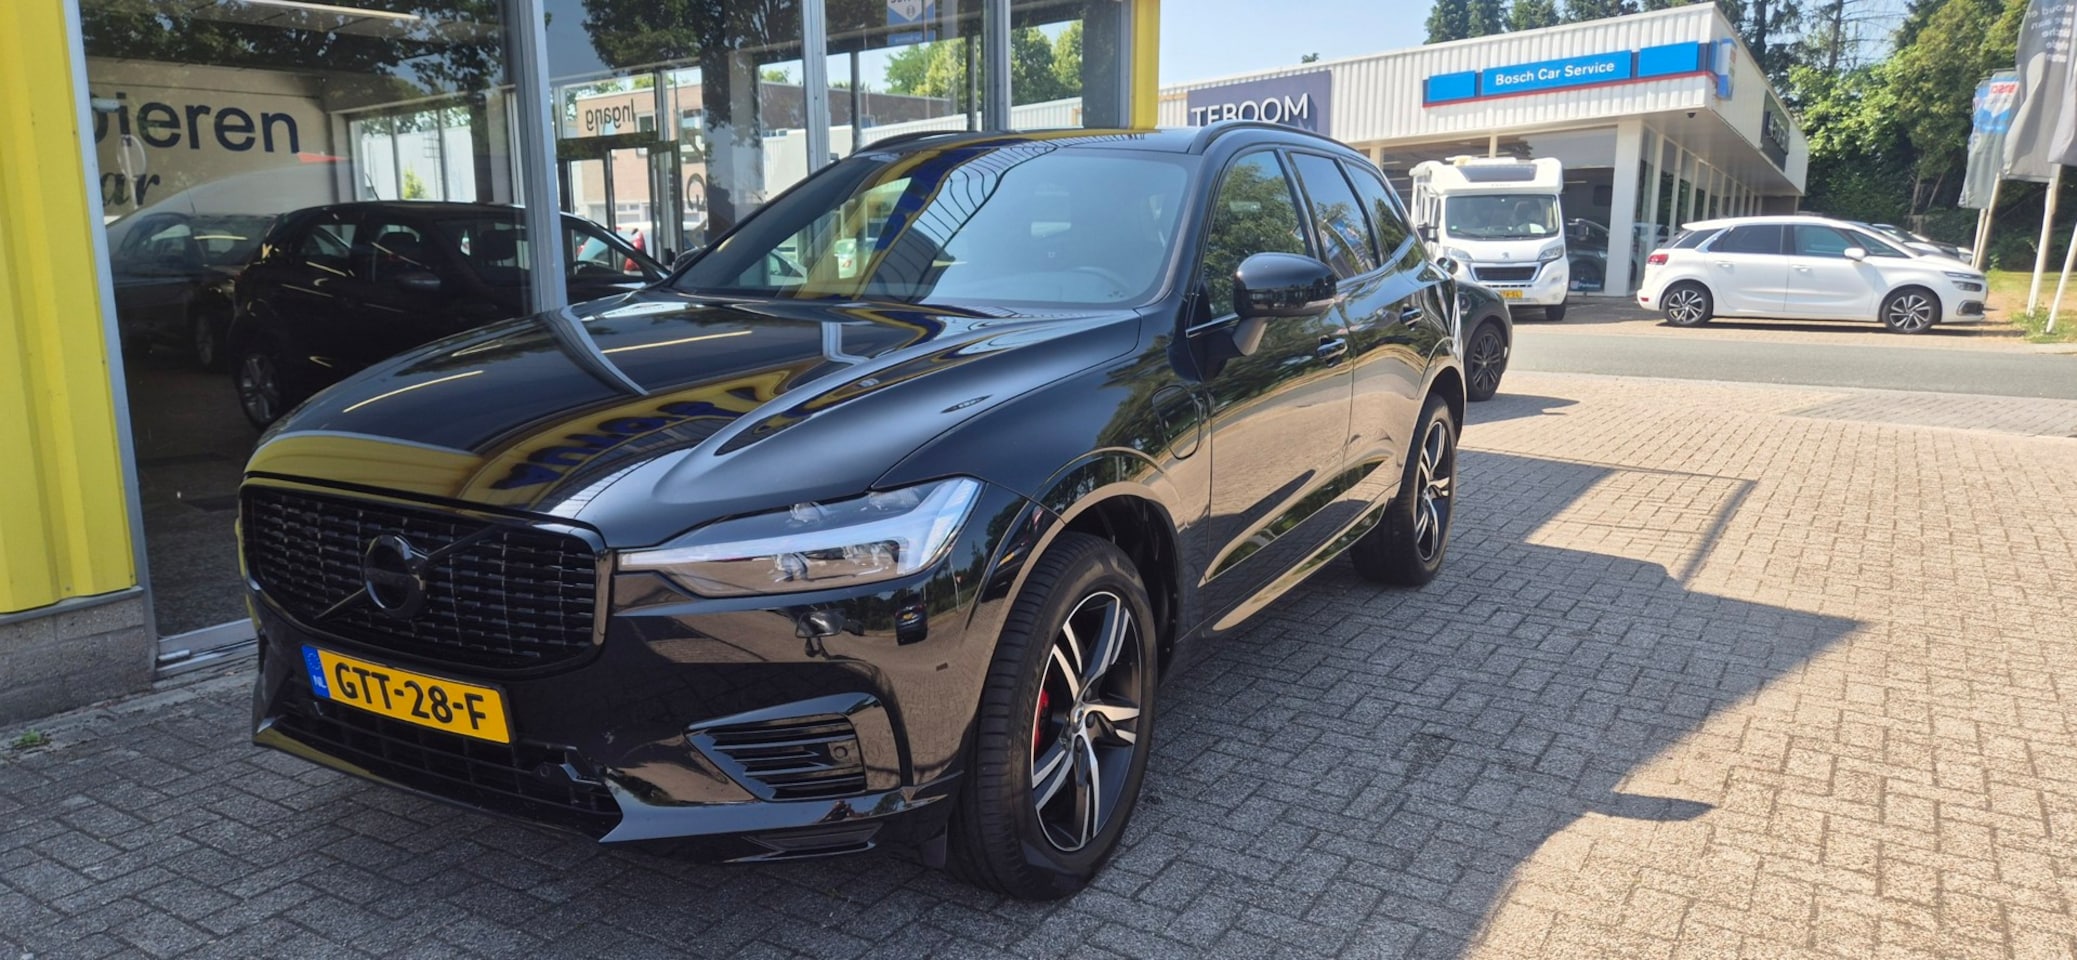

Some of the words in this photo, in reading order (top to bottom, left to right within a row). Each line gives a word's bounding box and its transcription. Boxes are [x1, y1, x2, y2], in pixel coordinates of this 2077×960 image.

[1495, 72, 1534, 86] Bosch
[1538, 67, 1560, 81] Car
[1564, 61, 1615, 78] Service
[1191, 92, 1308, 127] TEBOOM
[335, 662, 486, 730] GTT-28-F
